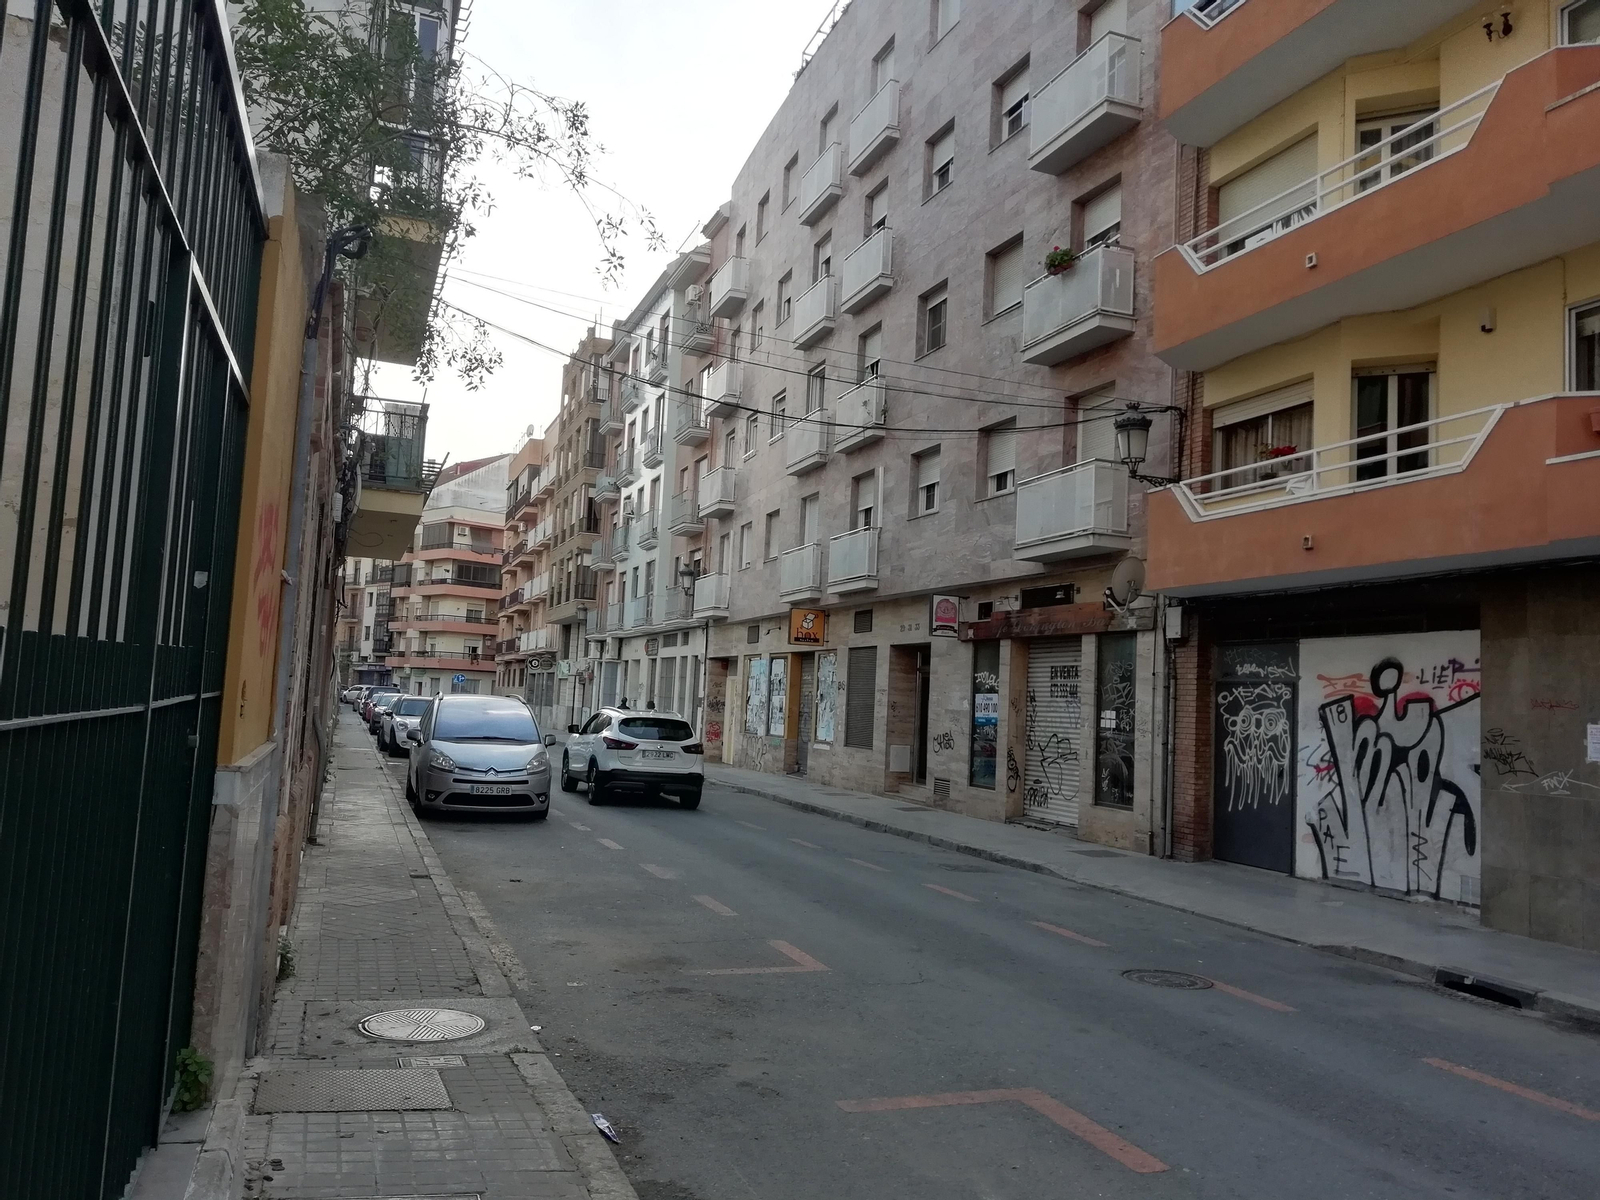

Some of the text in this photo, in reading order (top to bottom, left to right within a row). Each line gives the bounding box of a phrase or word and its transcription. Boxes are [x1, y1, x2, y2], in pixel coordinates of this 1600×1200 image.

[1050, 666, 1079, 680] EN VENTA
[475, 786, 511, 795] 8225 GRB
